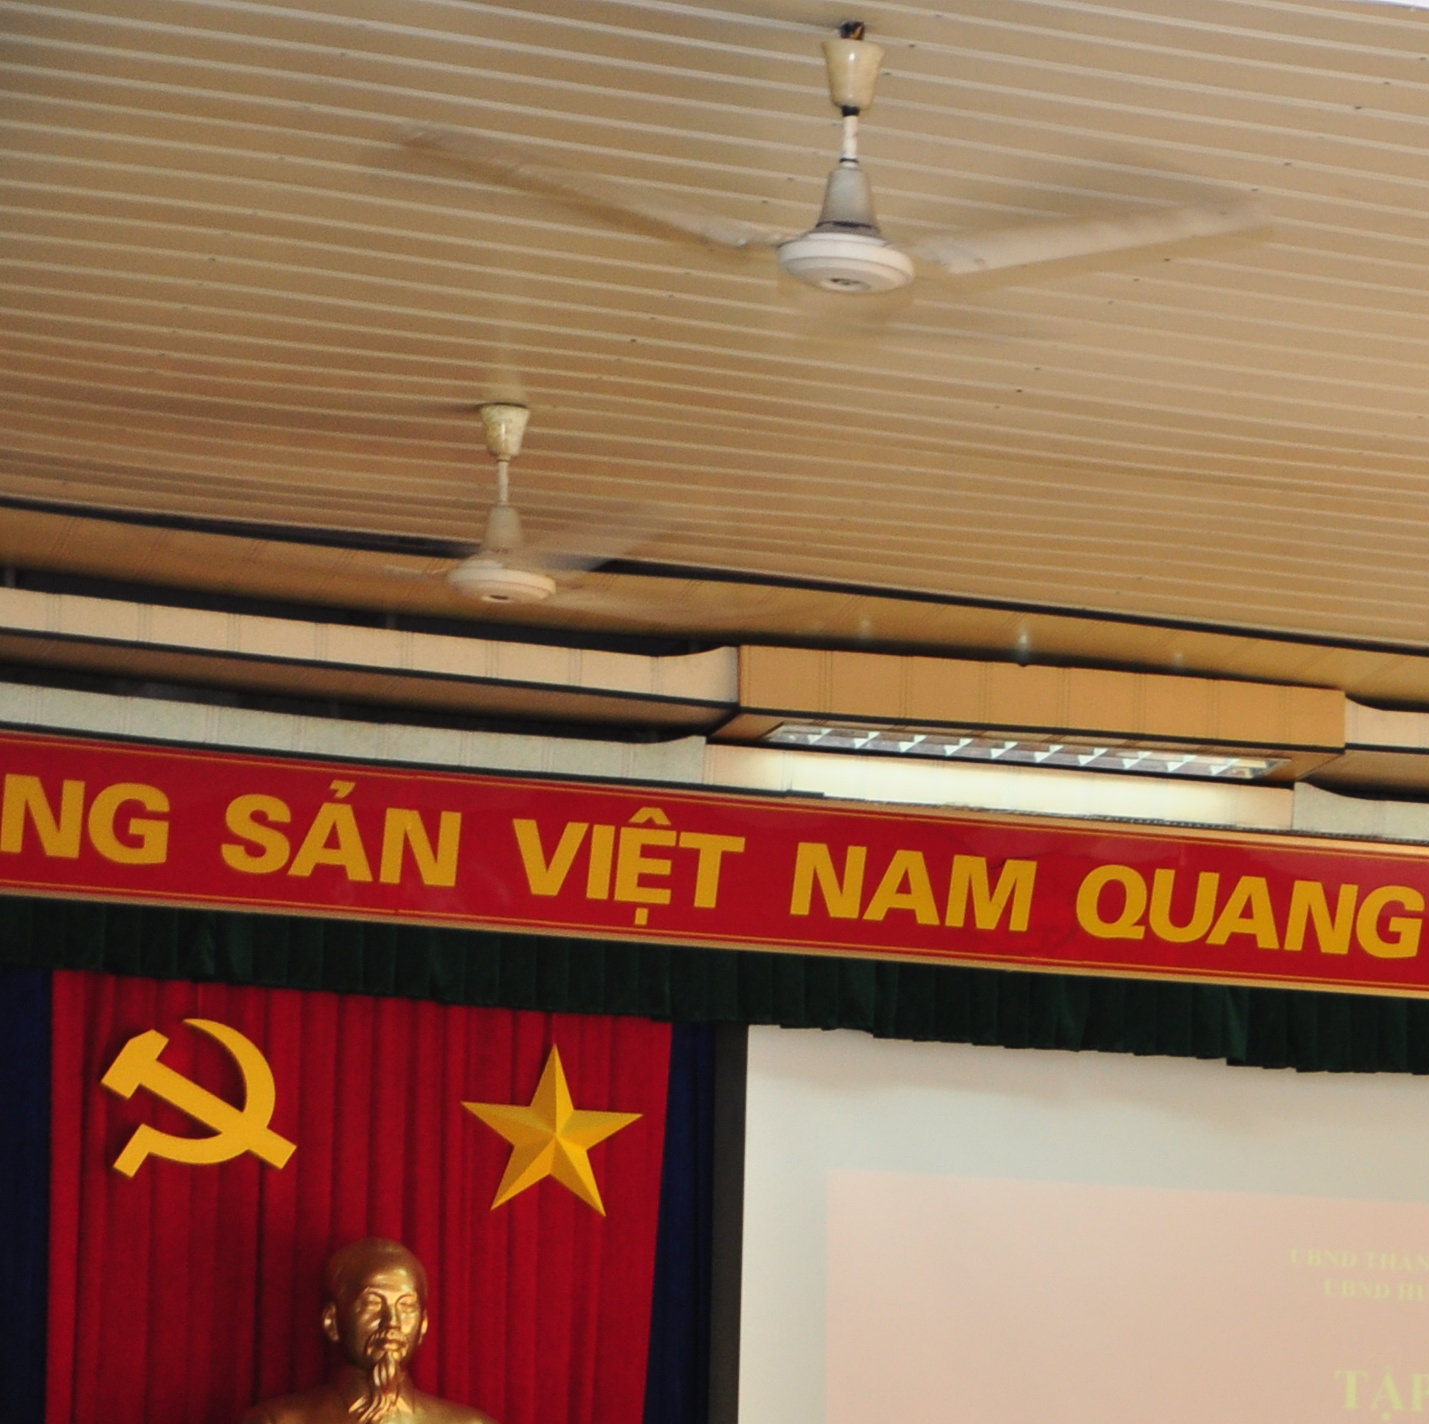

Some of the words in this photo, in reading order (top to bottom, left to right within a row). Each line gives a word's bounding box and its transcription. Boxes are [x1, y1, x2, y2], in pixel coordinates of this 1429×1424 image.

[221, 781, 462, 891] SẢN
[513, 808, 744, 925] VIỆT
[790, 842, 1038, 932] NAM
[1076, 863, 1428, 961] QUANG
